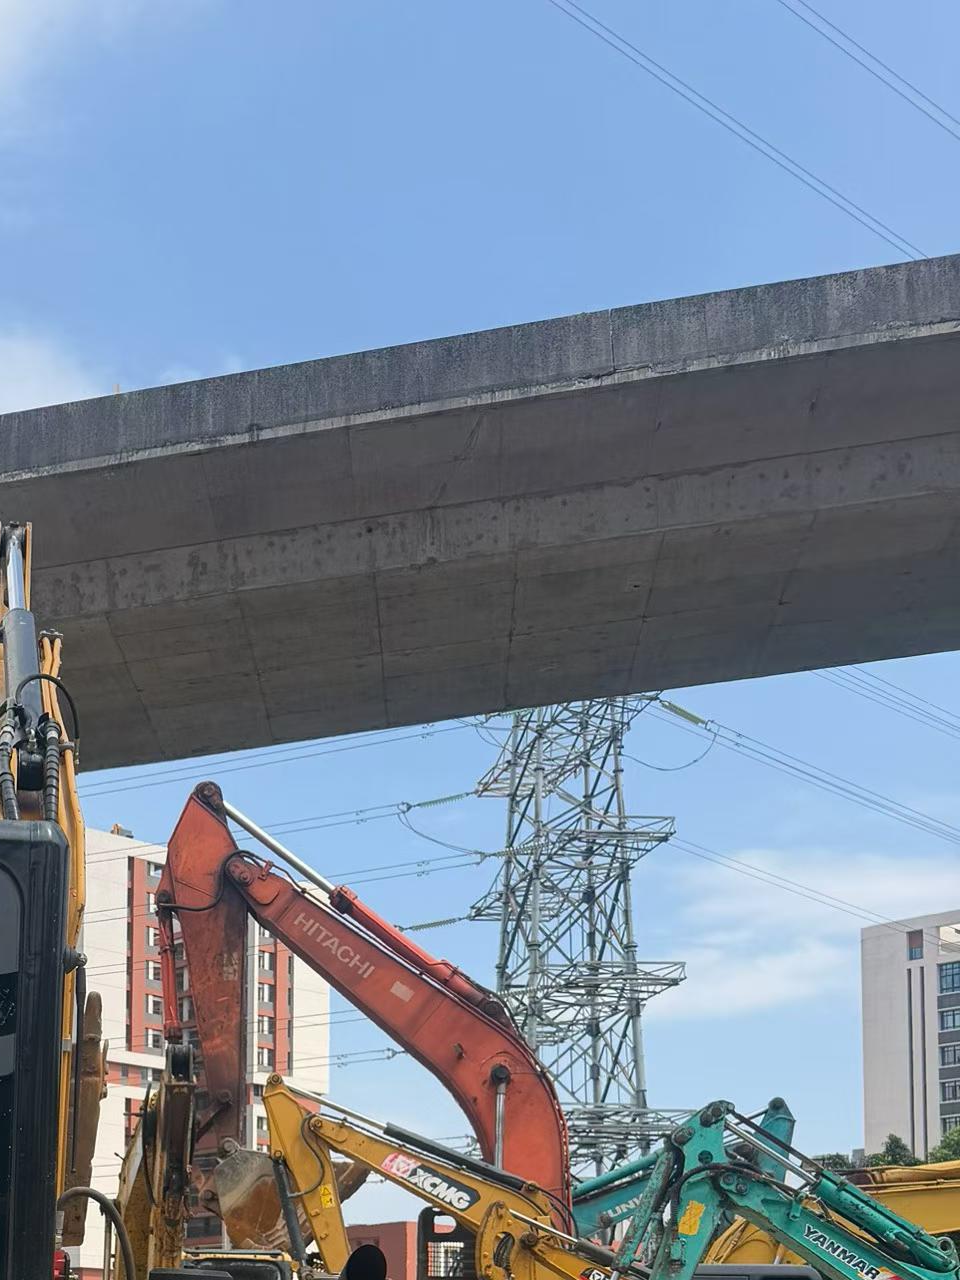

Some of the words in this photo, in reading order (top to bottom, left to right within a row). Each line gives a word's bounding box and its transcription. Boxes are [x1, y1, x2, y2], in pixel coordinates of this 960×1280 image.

[293, 912, 375, 979] HITACHI
[406, 1168, 471, 1210] XCMG
[803, 1223, 881, 1280] YANMAR
